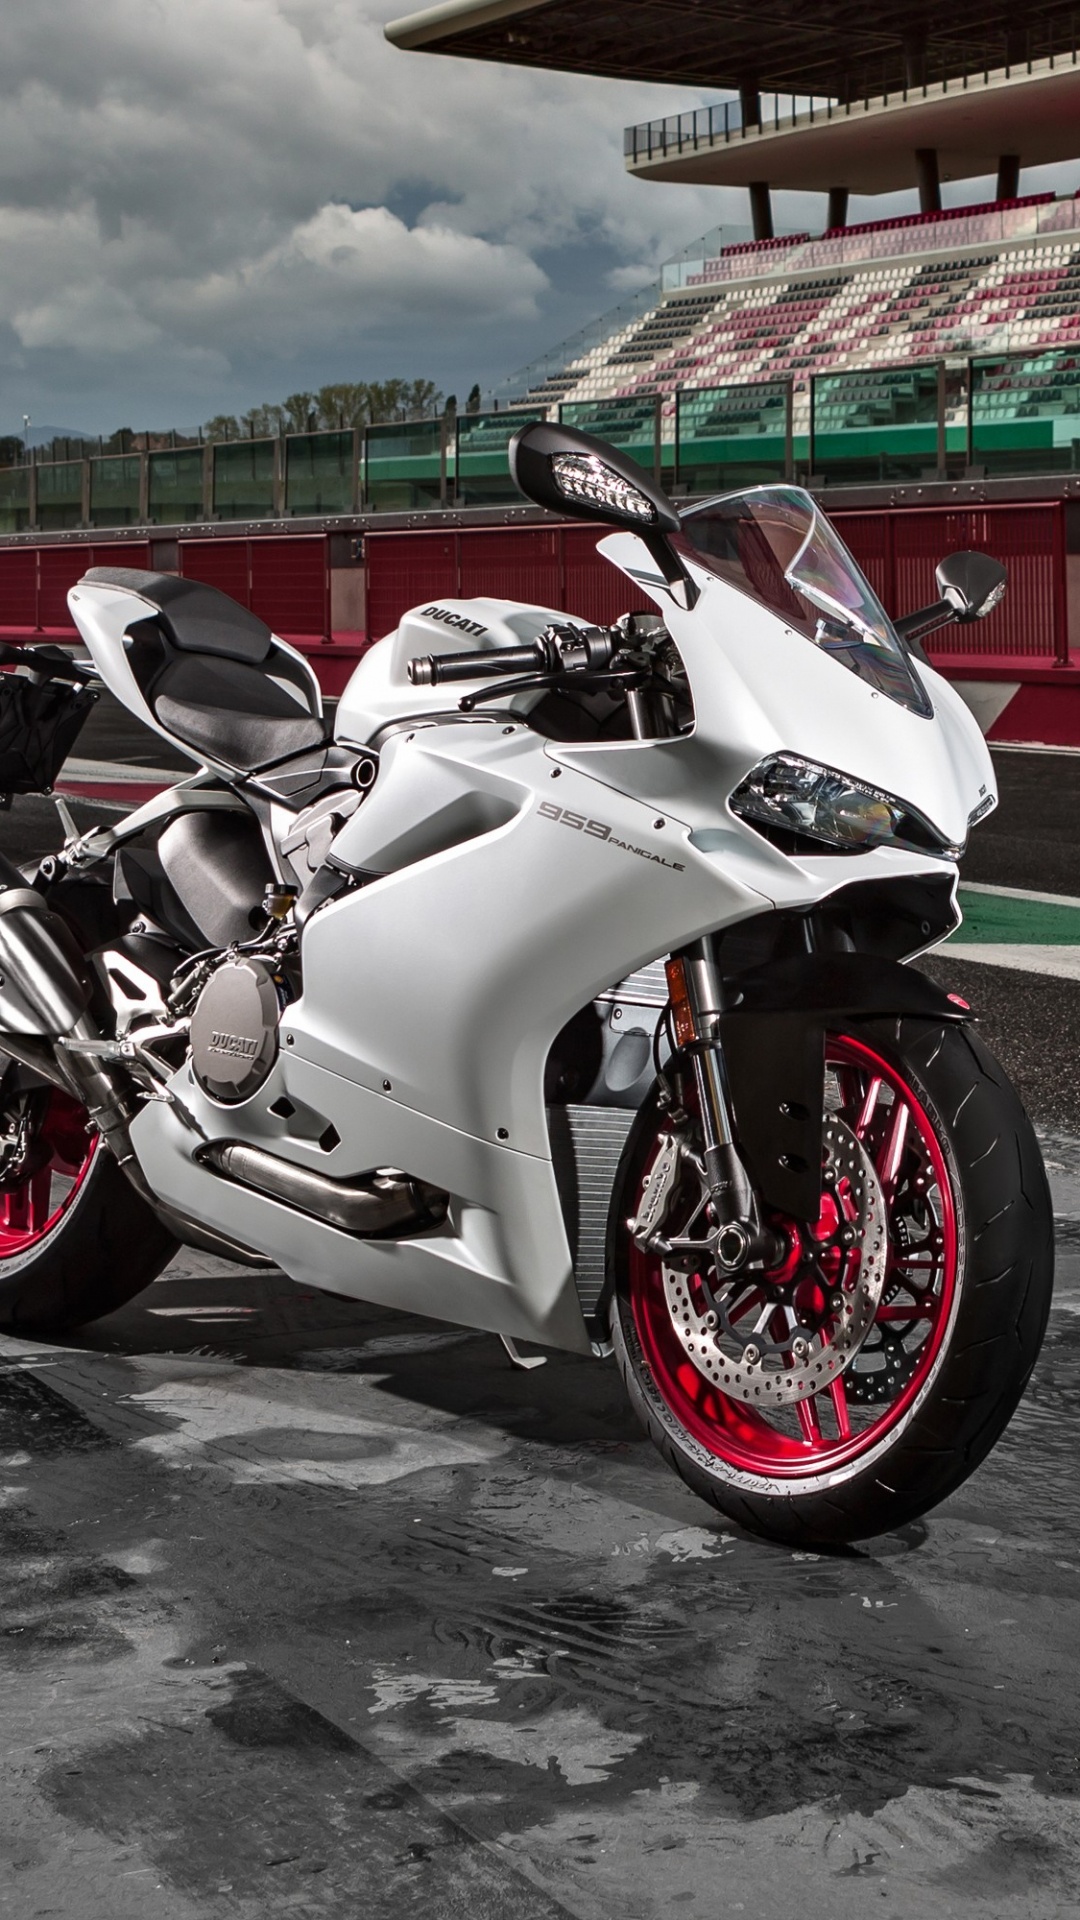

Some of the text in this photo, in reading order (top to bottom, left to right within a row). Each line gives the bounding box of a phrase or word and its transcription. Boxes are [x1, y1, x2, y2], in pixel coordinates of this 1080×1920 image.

[420, 606, 489, 637] DUCATI
[536, 801, 686, 872] 959 PANIGALE
[209, 1030, 258, 1056] DUCATI
